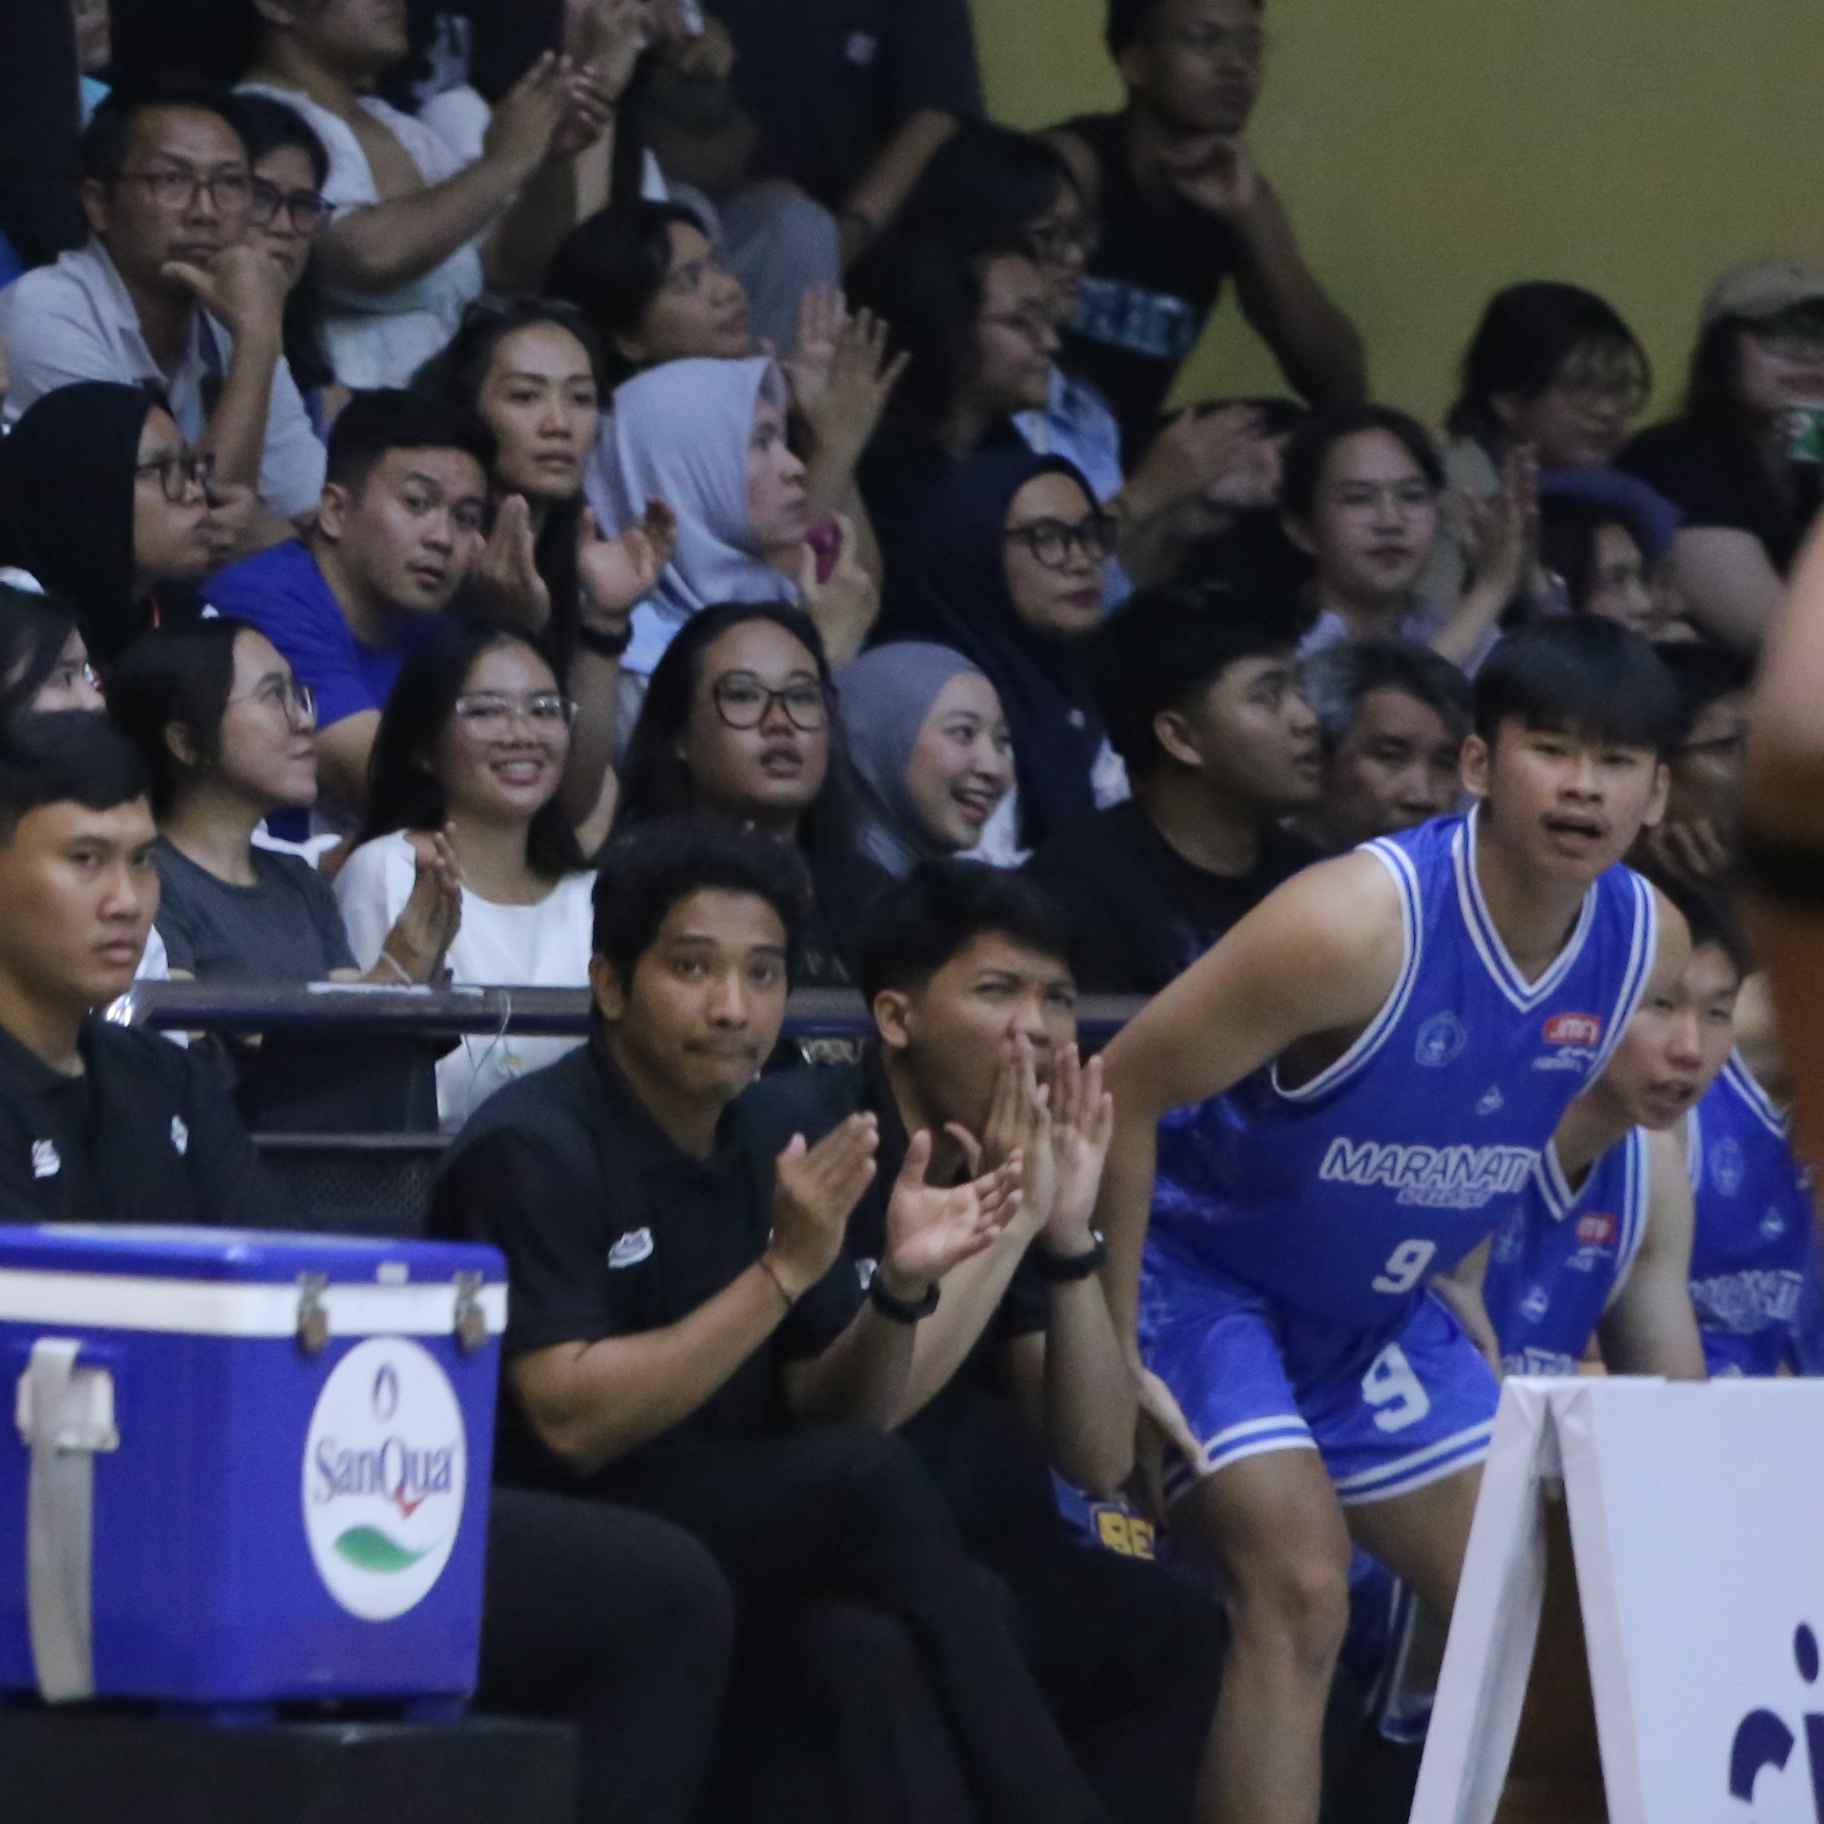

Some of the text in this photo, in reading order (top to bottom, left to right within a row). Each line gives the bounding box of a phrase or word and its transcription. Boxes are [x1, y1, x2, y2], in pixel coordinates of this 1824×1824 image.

[1318, 1136, 1541, 1194] MARANAT
[1371, 1238, 1438, 1295] 9
[1360, 1341, 1431, 1434] 9
[313, 1436, 456, 1520] SanQua
